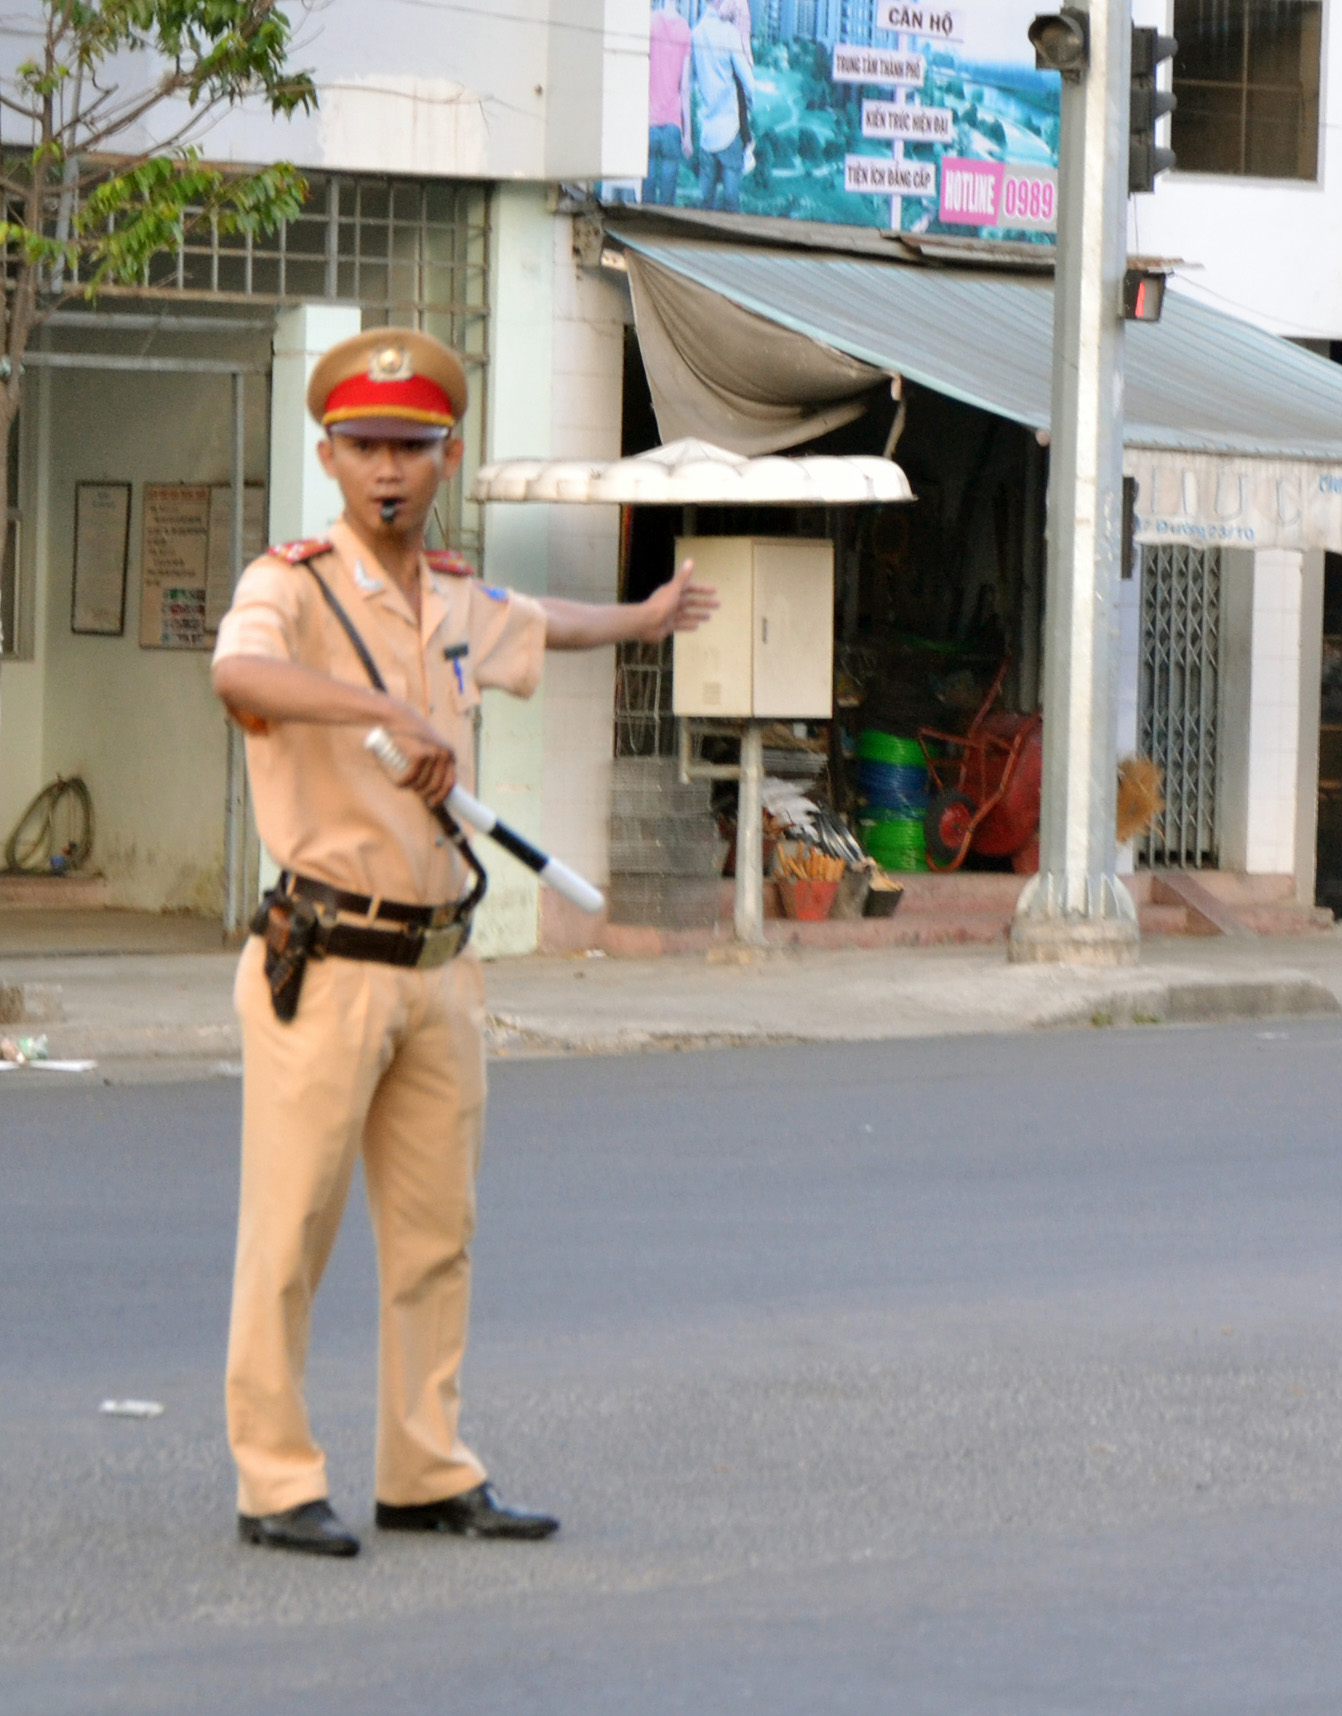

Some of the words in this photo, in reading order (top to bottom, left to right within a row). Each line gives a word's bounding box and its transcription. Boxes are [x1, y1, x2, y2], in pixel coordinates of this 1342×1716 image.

[930, 11, 953, 36] HỘ
[944, 169, 996, 216] HOTLINE
[1004, 176, 1055, 220] 0989
